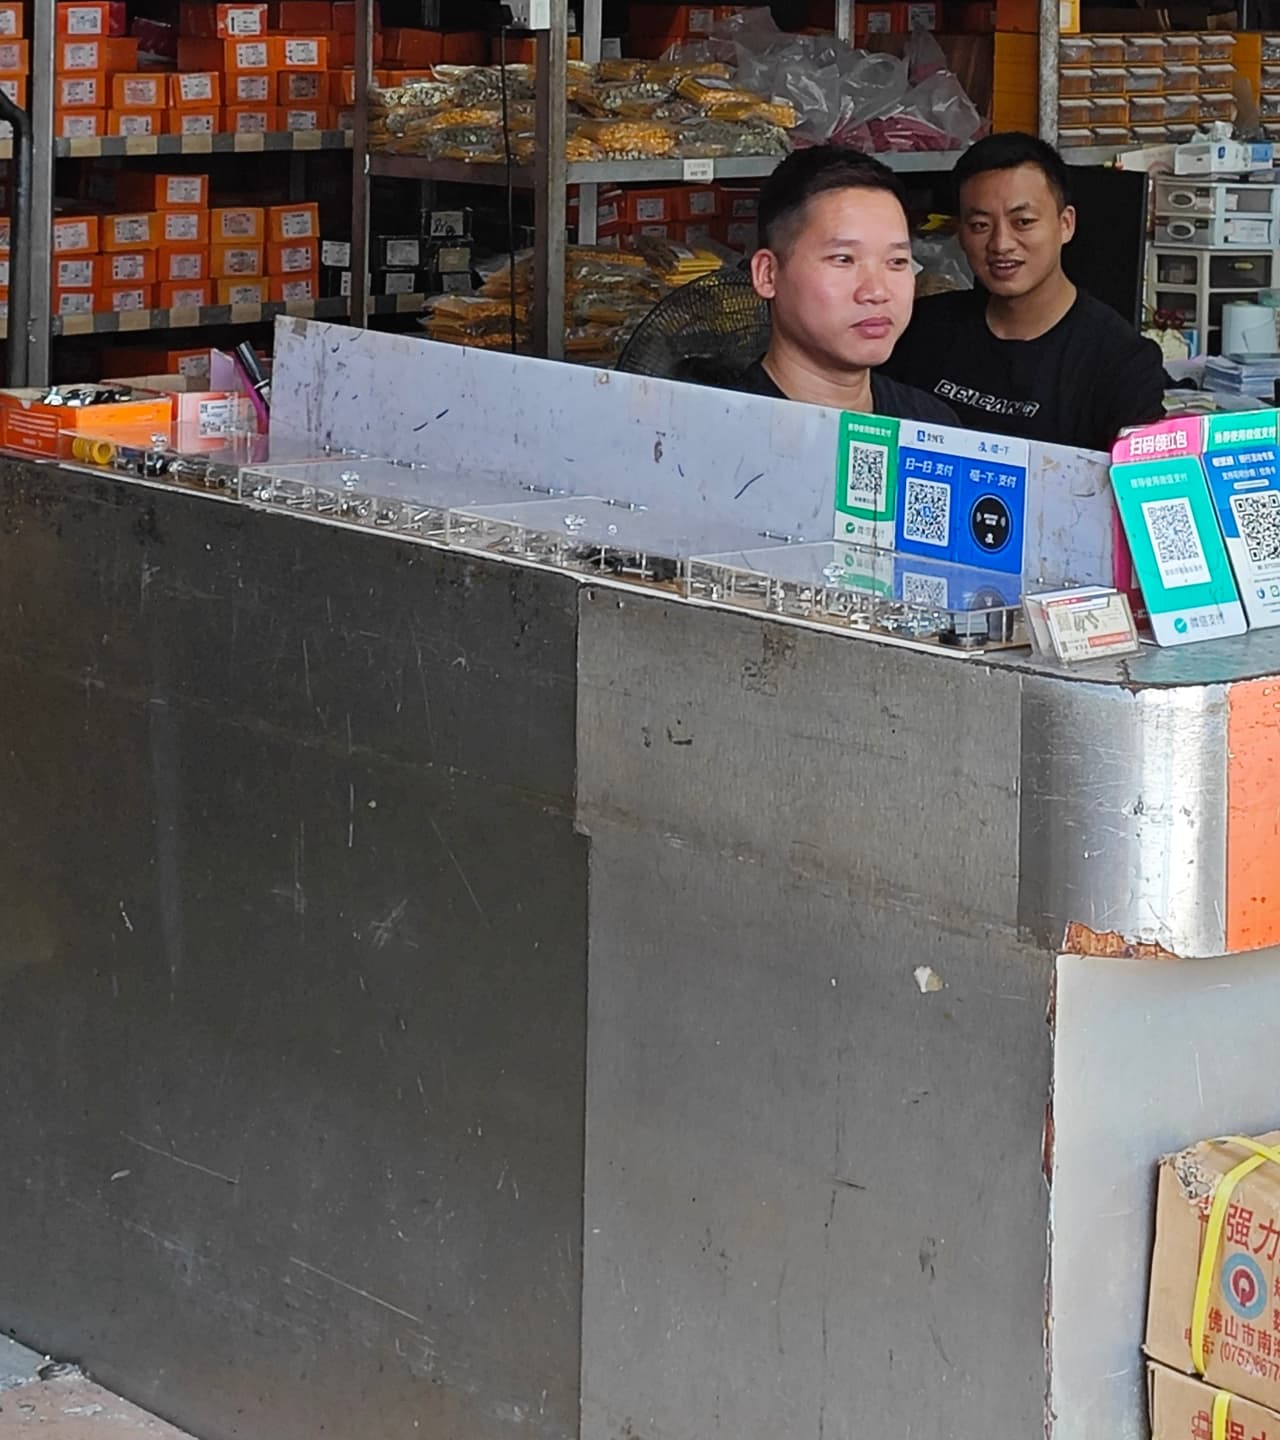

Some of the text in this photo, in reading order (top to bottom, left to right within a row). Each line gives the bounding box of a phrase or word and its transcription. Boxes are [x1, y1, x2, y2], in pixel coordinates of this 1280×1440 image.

[1130, 431, 1187, 455] 扫码领红包
